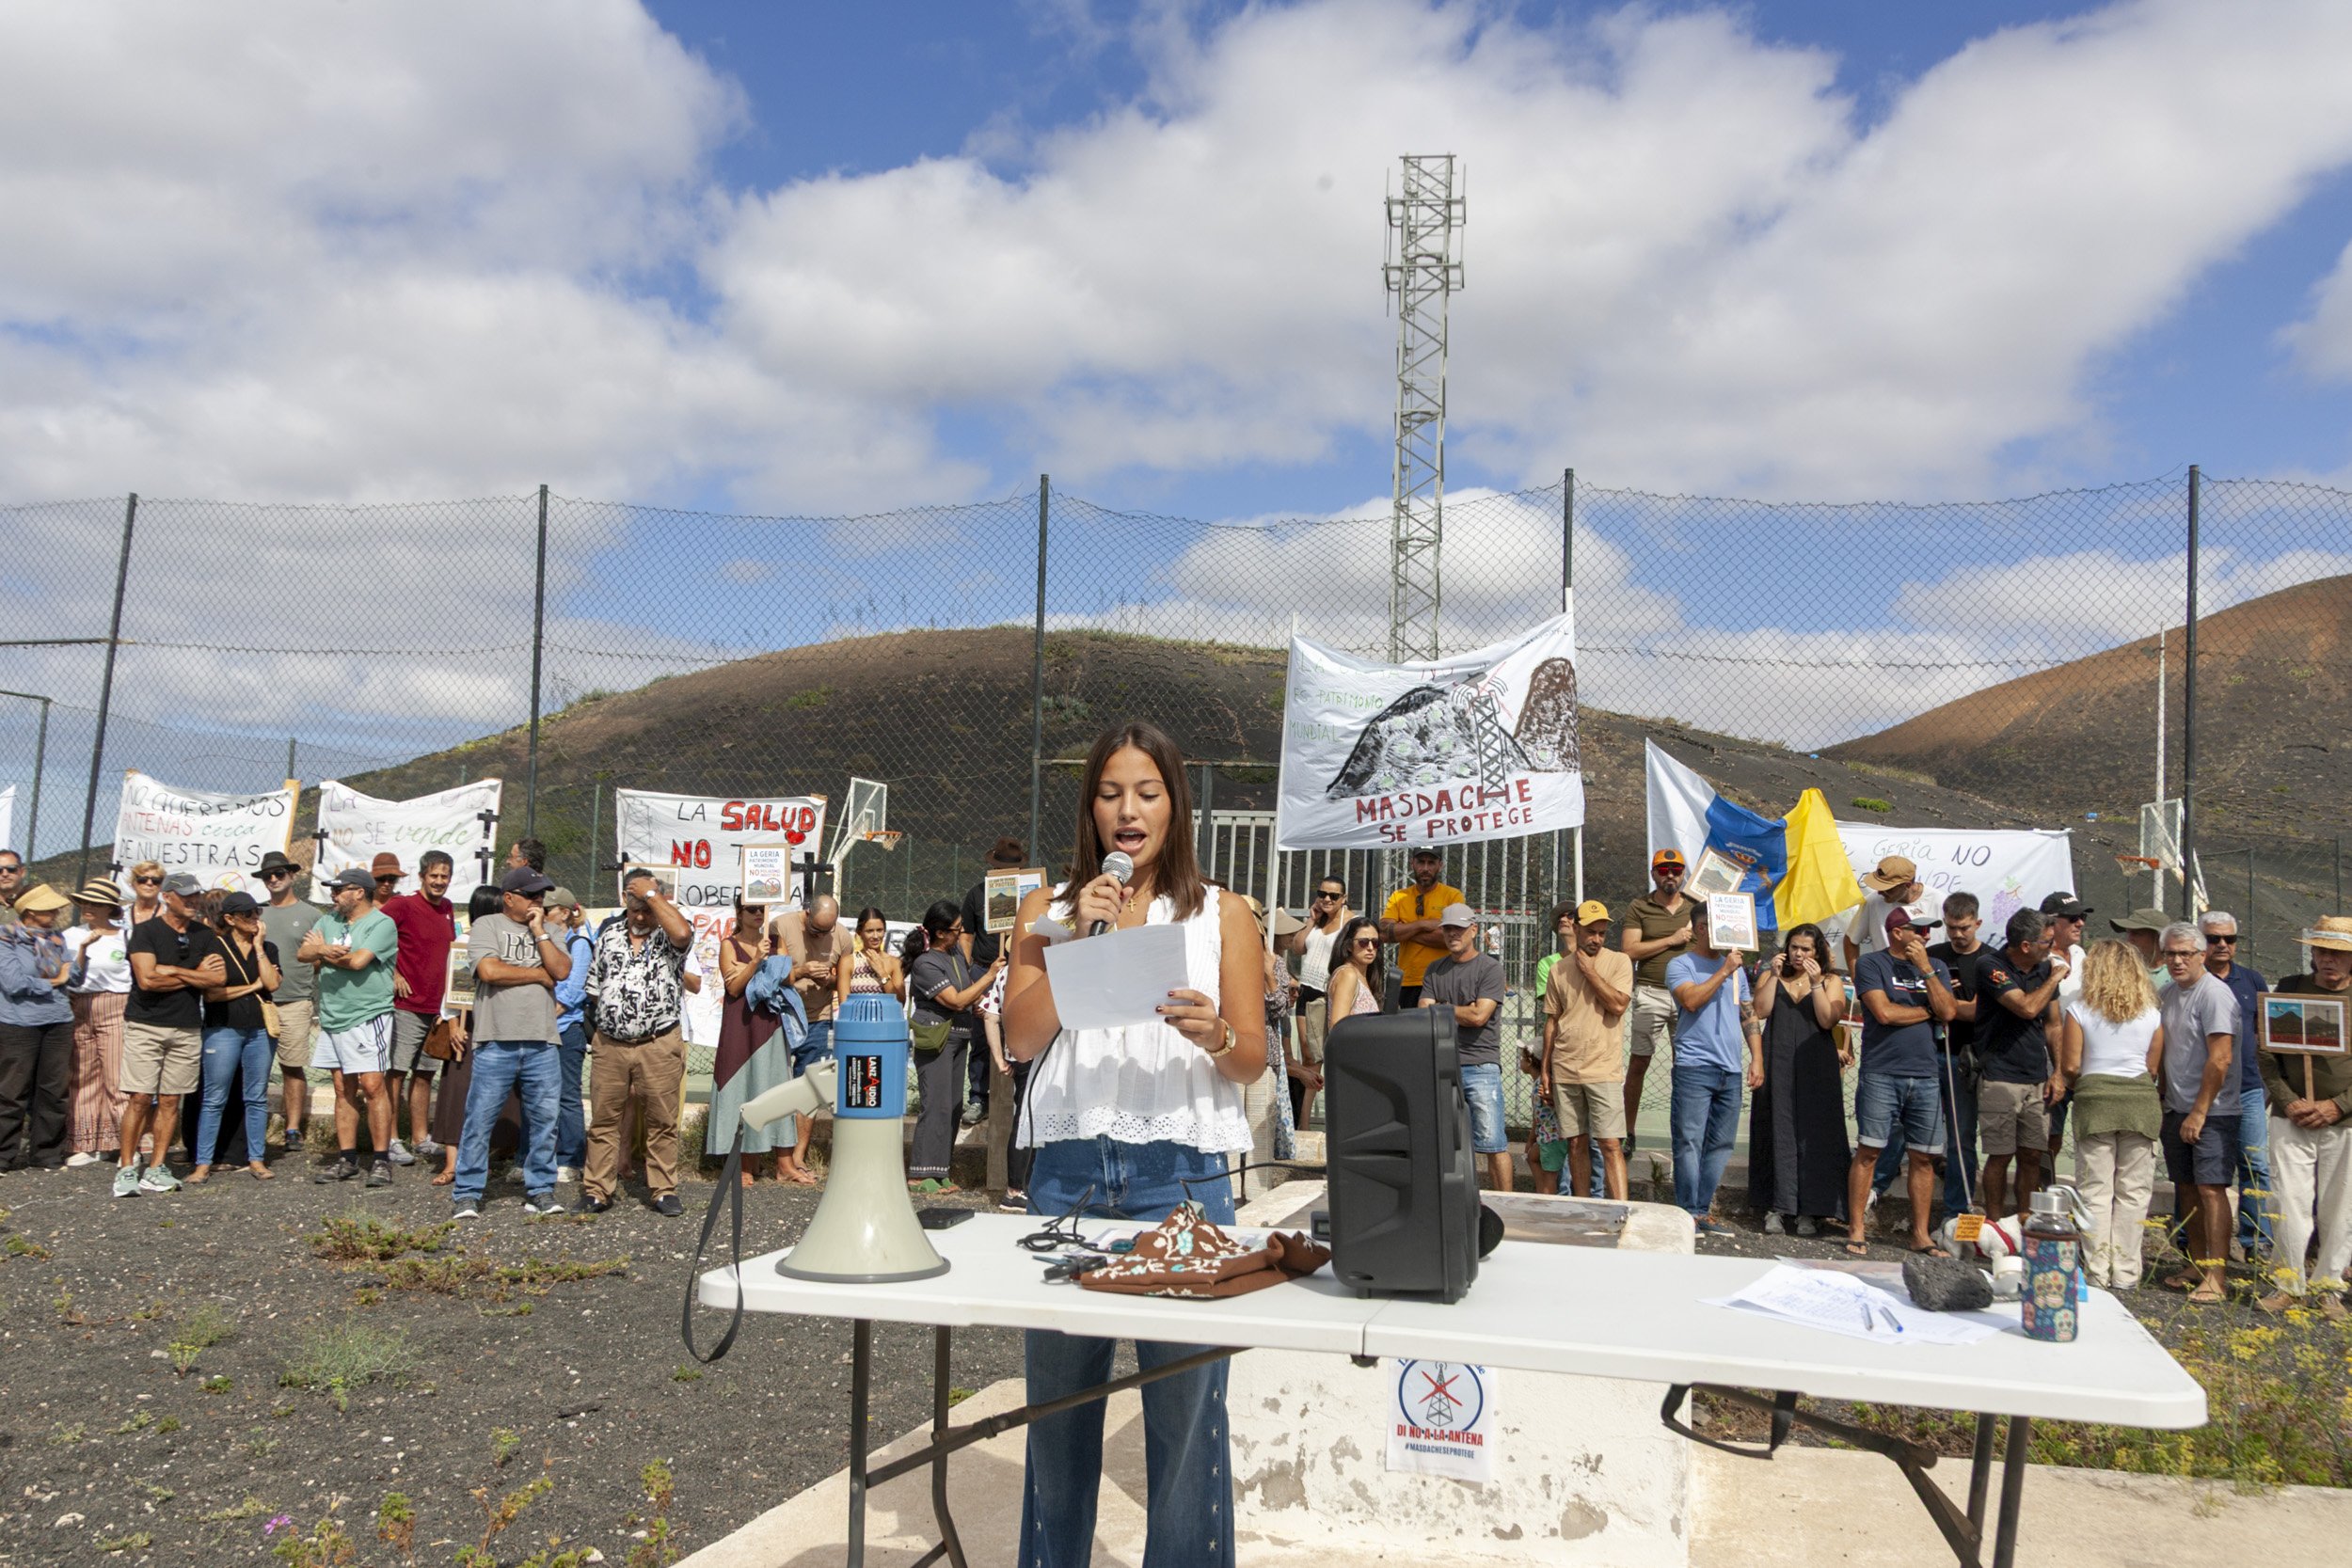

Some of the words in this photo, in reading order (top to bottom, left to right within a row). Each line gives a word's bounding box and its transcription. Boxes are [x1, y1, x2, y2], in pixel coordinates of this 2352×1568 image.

[1317, 689, 1384, 710] PATRIMONIO
[1356, 779, 1534, 824] MASDACHE
[122, 811, 194, 837] ANTENAS
[677, 801, 707, 822] LA
[721, 800, 817, 832] SALUD
[1378, 824, 1407, 843] SE
[1426, 807, 1534, 839] PROTEGE
[362, 820, 386, 846] SE
[394, 820, 475, 847] vende
[670, 839, 712, 870] NO
[1951, 844, 1992, 867] NO
[865, 1056, 880, 1107] LANZAUDIO
[1397, 1424, 1406, 1437] DI
[1408, 1425, 1422, 1439] NO
[1424, 1427, 1431, 1440] A
[1434, 1429, 1445, 1441] LA
[1448, 1431, 1484, 1447] ANTENA
[1405, 1442, 1475, 1459] #MASDACHESEPROTEGE
